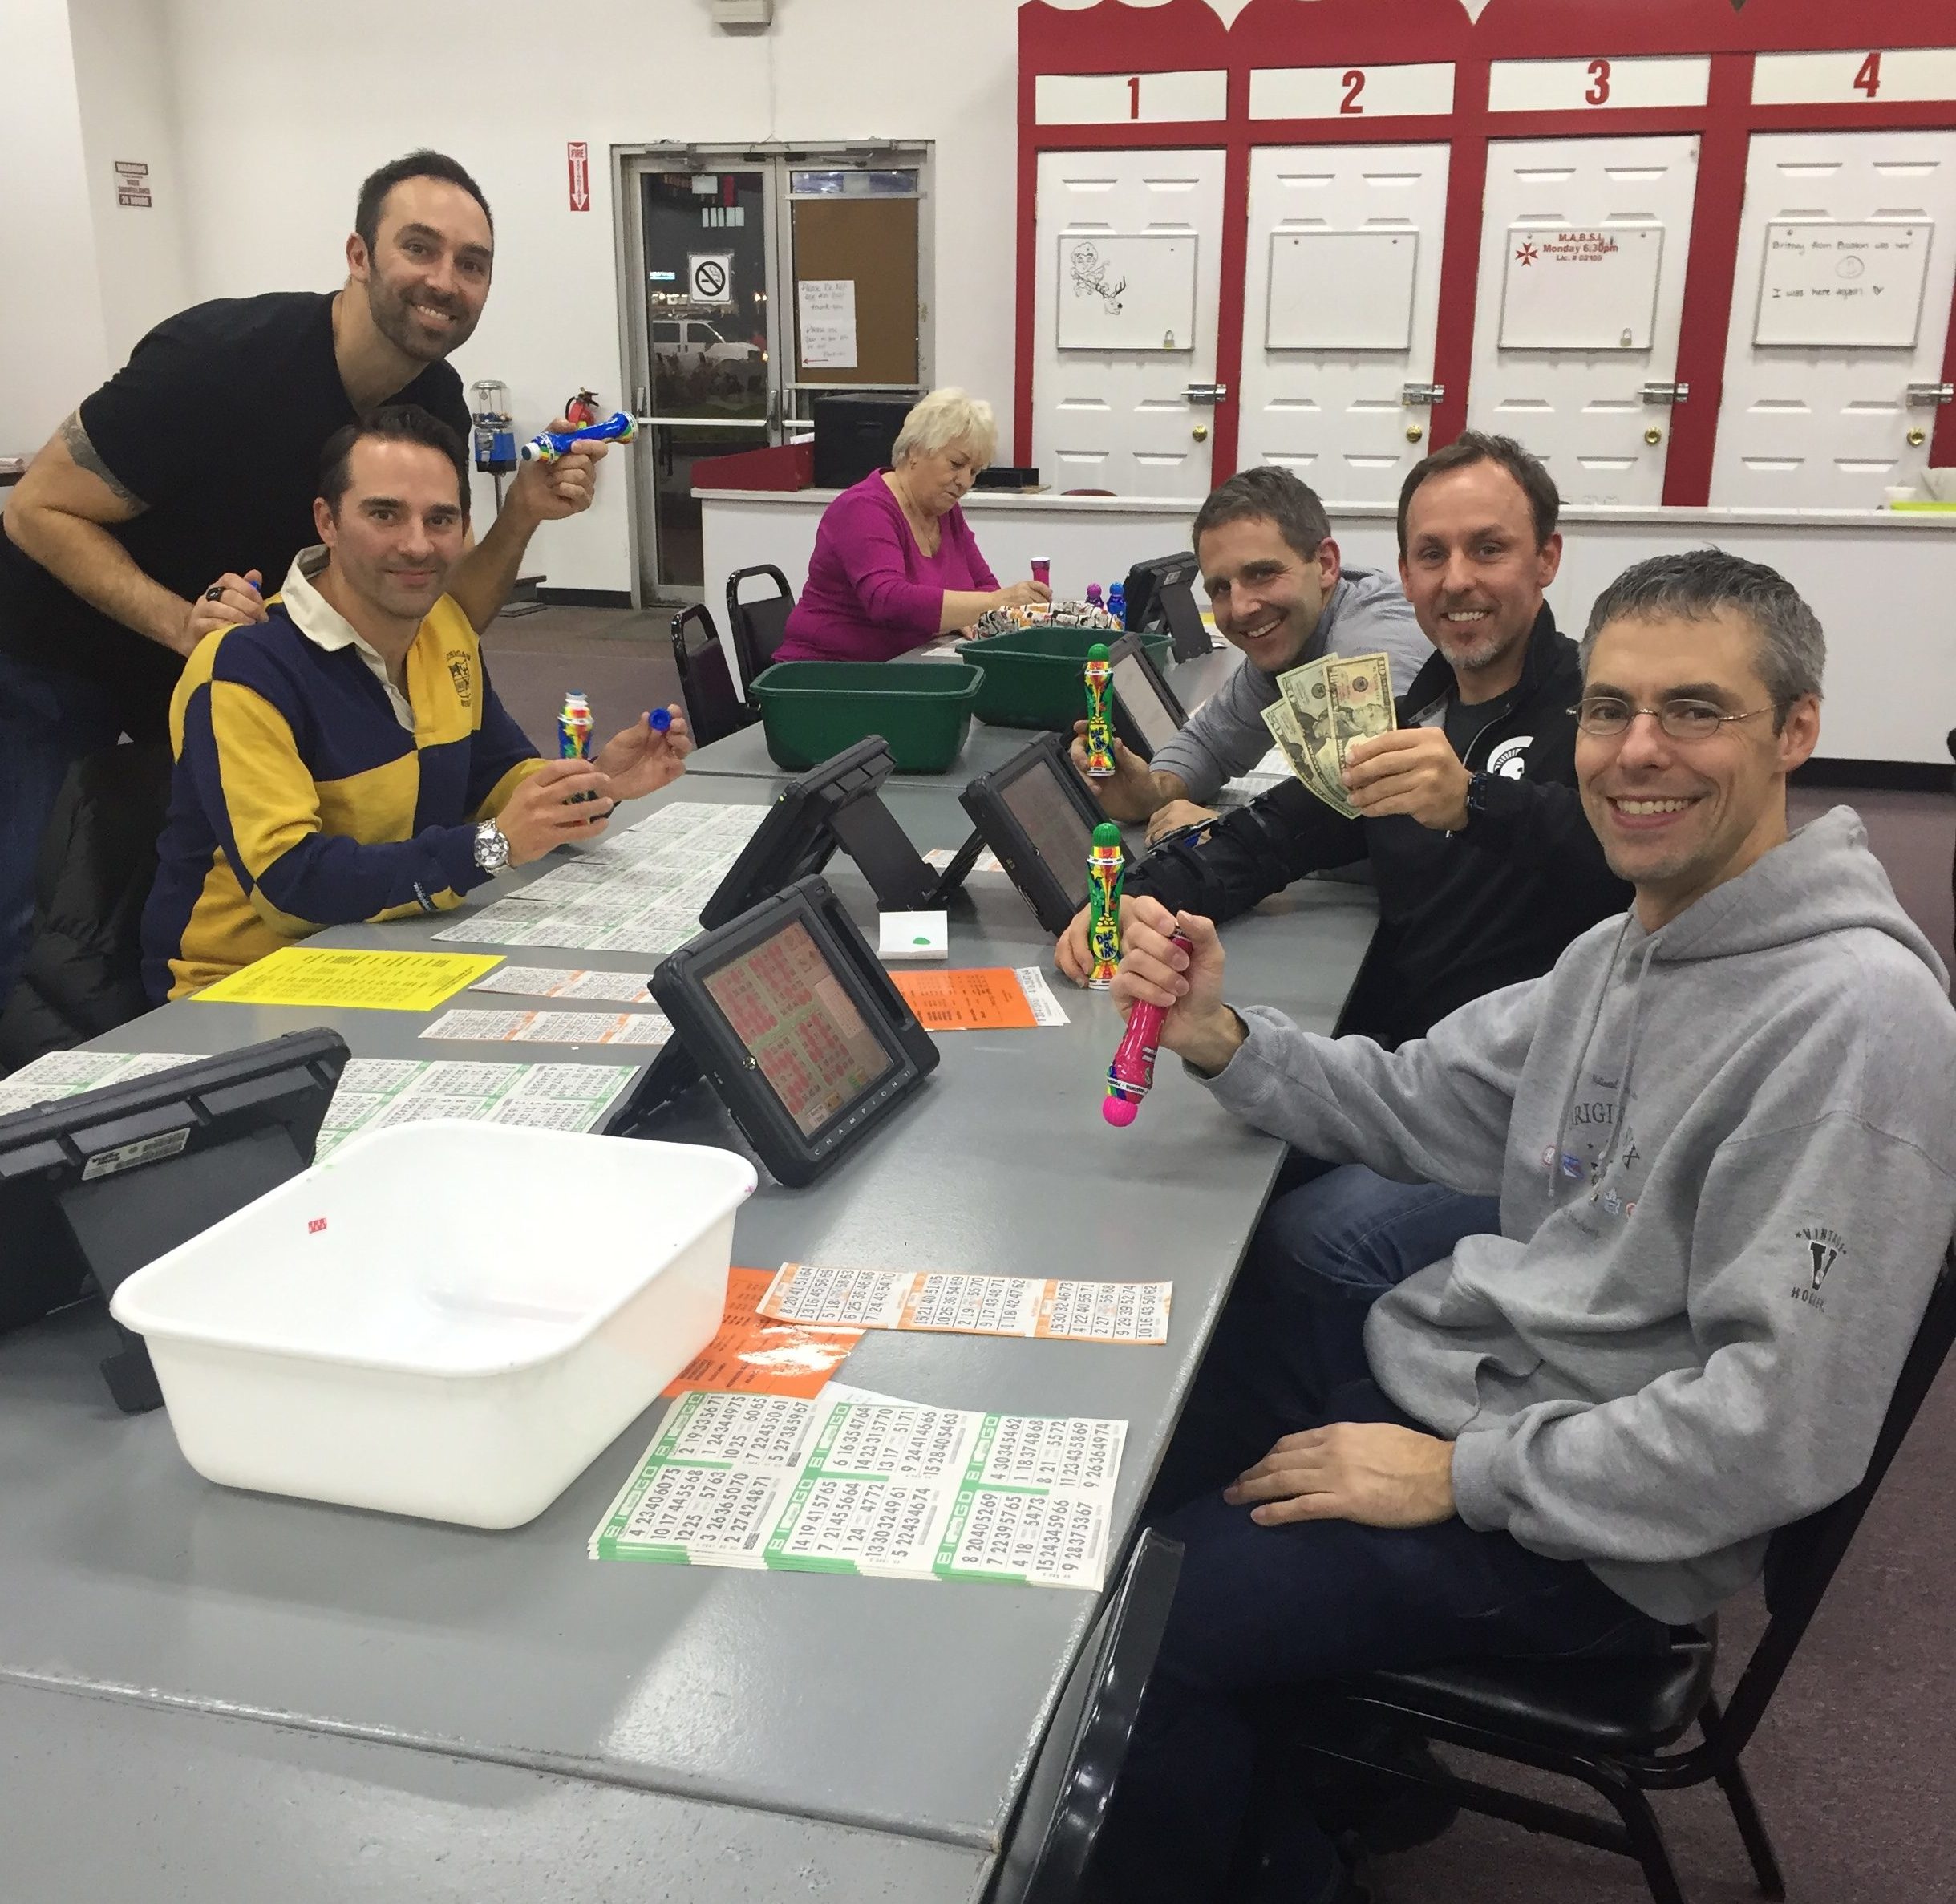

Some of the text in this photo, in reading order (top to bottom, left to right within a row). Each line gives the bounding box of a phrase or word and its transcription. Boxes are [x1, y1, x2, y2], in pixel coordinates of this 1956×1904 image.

[1855, 53, 1879, 95] 4
[1587, 61, 1609, 104] 3
[1129, 78, 1138, 117] 1
[1342, 71, 1363, 112] 2
[1543, 244, 1580, 253] Monday
[1095, 930, 1114, 944] DAB
[813, 1081, 898, 1156] CHAMPION
[856, 1408, 871, 1418] 64
[849, 1418, 865, 1429] 47
[1006, 1419, 1022, 1429] 62
[1028, 1420, 1044, 1431] 68
[1050, 1422, 1066, 1432] 72
[1073, 1423, 1088, 1434] 69
[1095, 1424, 1110, 1434] 74
[843, 1431, 861, 1442] 35
[1001, 1432, 1018, 1443] 54
[1024, 1433, 1041, 1444] 48
[1047, 1435, 1063, 1446] 55
[1069, 1436, 1086, 1448] 58
[1092, 1437, 1108, 1449] 49
[837, 1445, 855, 1454] 16
[998, 1445, 1014, 1456] 34
[1020, 1446, 1036, 1458] 37
[1067, 1450, 1083, 1461] 43
[993, 1457, 1010, 1469] 30
[1089, 1451, 1105, 1463] 36
[1016, 1460, 1033, 1469] 18
[1039, 1462, 1056, 1473] 21
[1063, 1463, 1079, 1476] 23
[661, 1469, 681, 1481] 75
[1086, 1465, 1103, 1477] 26
[654, 1482, 672, 1495] 60
[842, 1483, 860, 1496] 64
[865, 1485, 885, 1497] 72
[890, 1487, 907, 1498] 61
[912, 1489, 930, 1501] 74
[980, 1493, 998, 1508] 69
[645, 1497, 664, 1509] 40
[650, 1470, 703, 1538] 10 17 44 55 68
[836, 1497, 855, 1510] 56
[860, 1498, 877, 1512] 47
[884, 1501, 901, 1514] 49
[1004, 1497, 1022, 1509] 65
[1027, 1498, 1046, 1511] 73
[1052, 1500, 1069, 1513] 66
[1076, 1501, 1092, 1516] 67
[908, 1503, 925, 1516] 46
[975, 1509, 994, 1522] 52
[635, 1511, 655, 1524] 23
[792, 1482, 837, 1550] 14 19 41 57 65
[829, 1513, 848, 1525] 45
[999, 1511, 1016, 1524] 57
[1023, 1513, 1041, 1526] 54
[1048, 1515, 1065, 1529] 59
[877, 1516, 897, 1529] 32
[901, 1518, 920, 1530] 43
[1072, 1517, 1090, 1530] 53
[823, 1527, 841, 1538] 21
[847, 1529, 866, 1541] 24
[970, 1524, 989, 1537] 40
[994, 1525, 1013, 1538] 39
[1043, 1530, 1062, 1543] 34
[871, 1531, 890, 1543] 30
[895, 1533, 914, 1545] 22
[1068, 1532, 1086, 1545] 37
[865, 1545, 884, 1556] 13
[966, 1539, 984, 1551] 20
[990, 1541, 1009, 1553] 22
[1015, 1544, 1033, 1553] 18
[1039, 1545, 1058, 1558] 24
[1065, 1547, 1083, 1559] 28
[1036, 1559, 1054, 1570] 15
